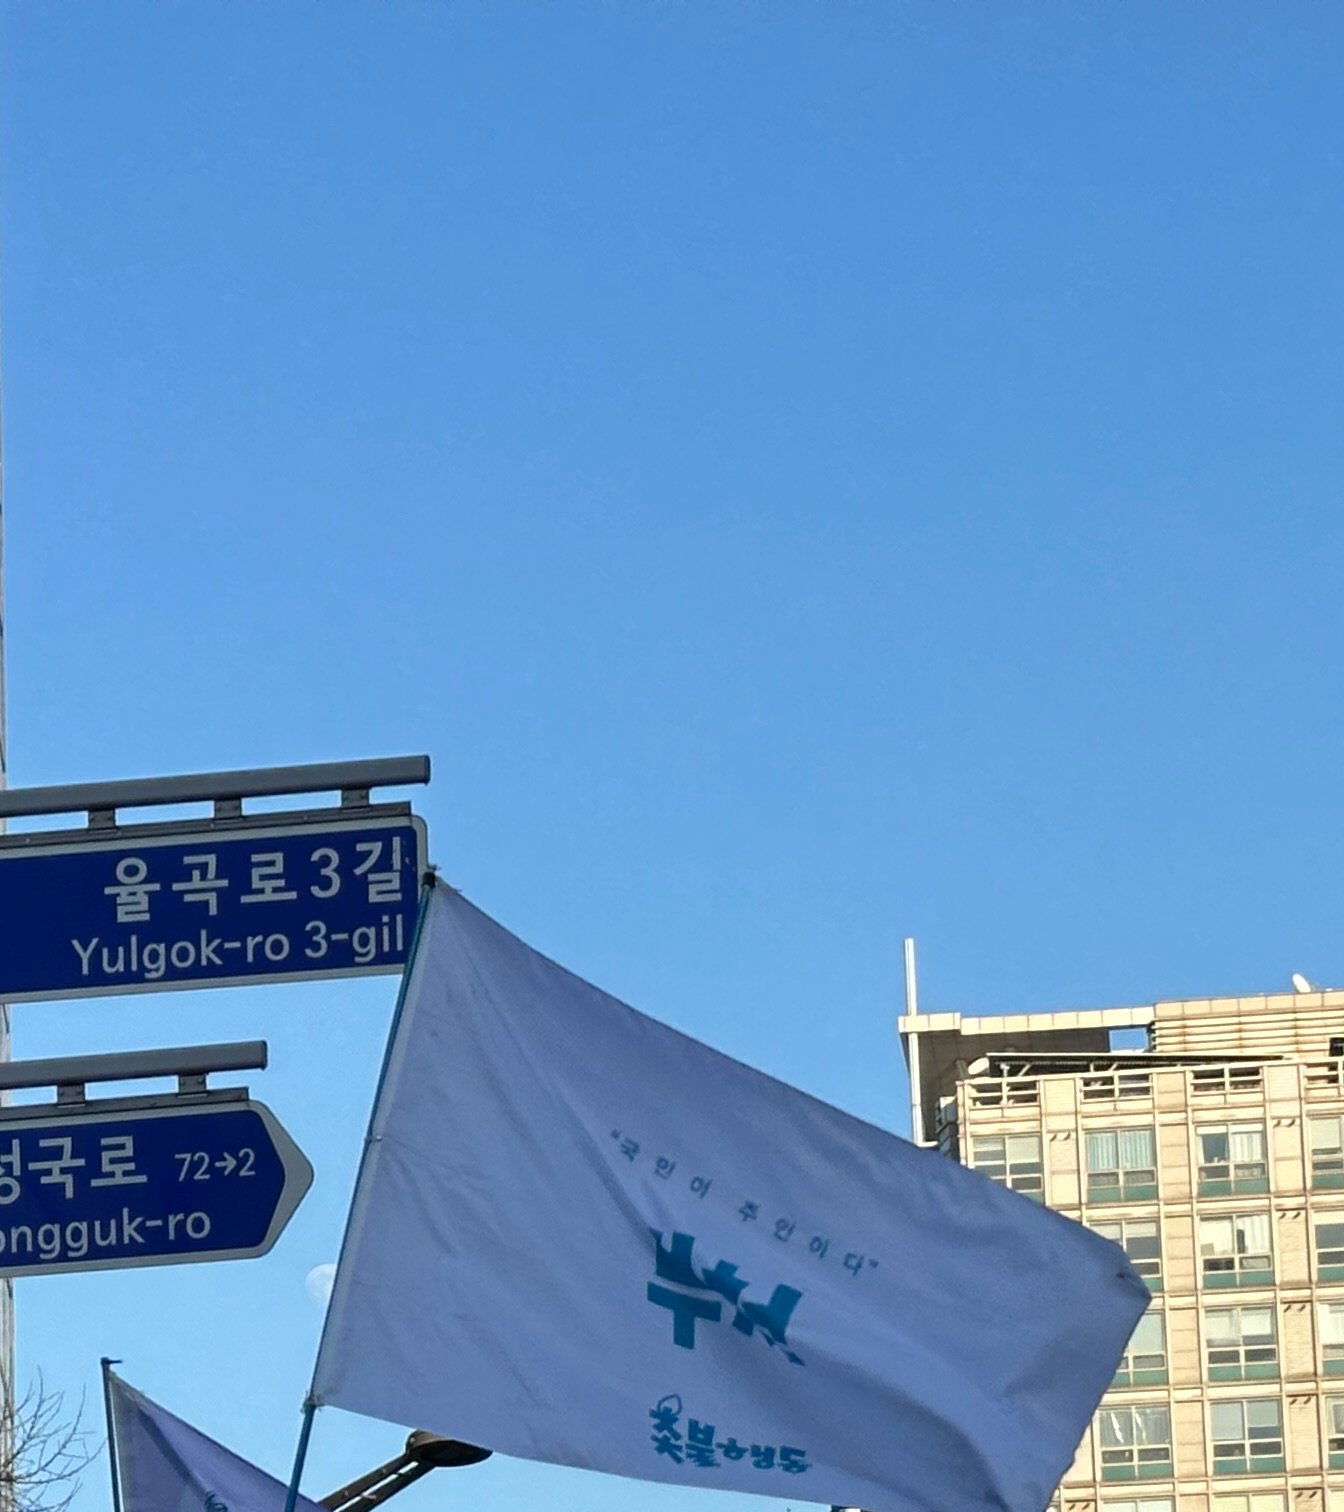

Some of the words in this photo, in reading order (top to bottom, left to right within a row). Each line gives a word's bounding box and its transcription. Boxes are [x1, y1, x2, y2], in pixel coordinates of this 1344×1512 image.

[104, 836, 403, 923] 율곡로3길
[72, 929, 290, 979] Yulgok-ro
[304, 914, 404, 965] 3-gil
[174, 1151, 211, 1183] 72
